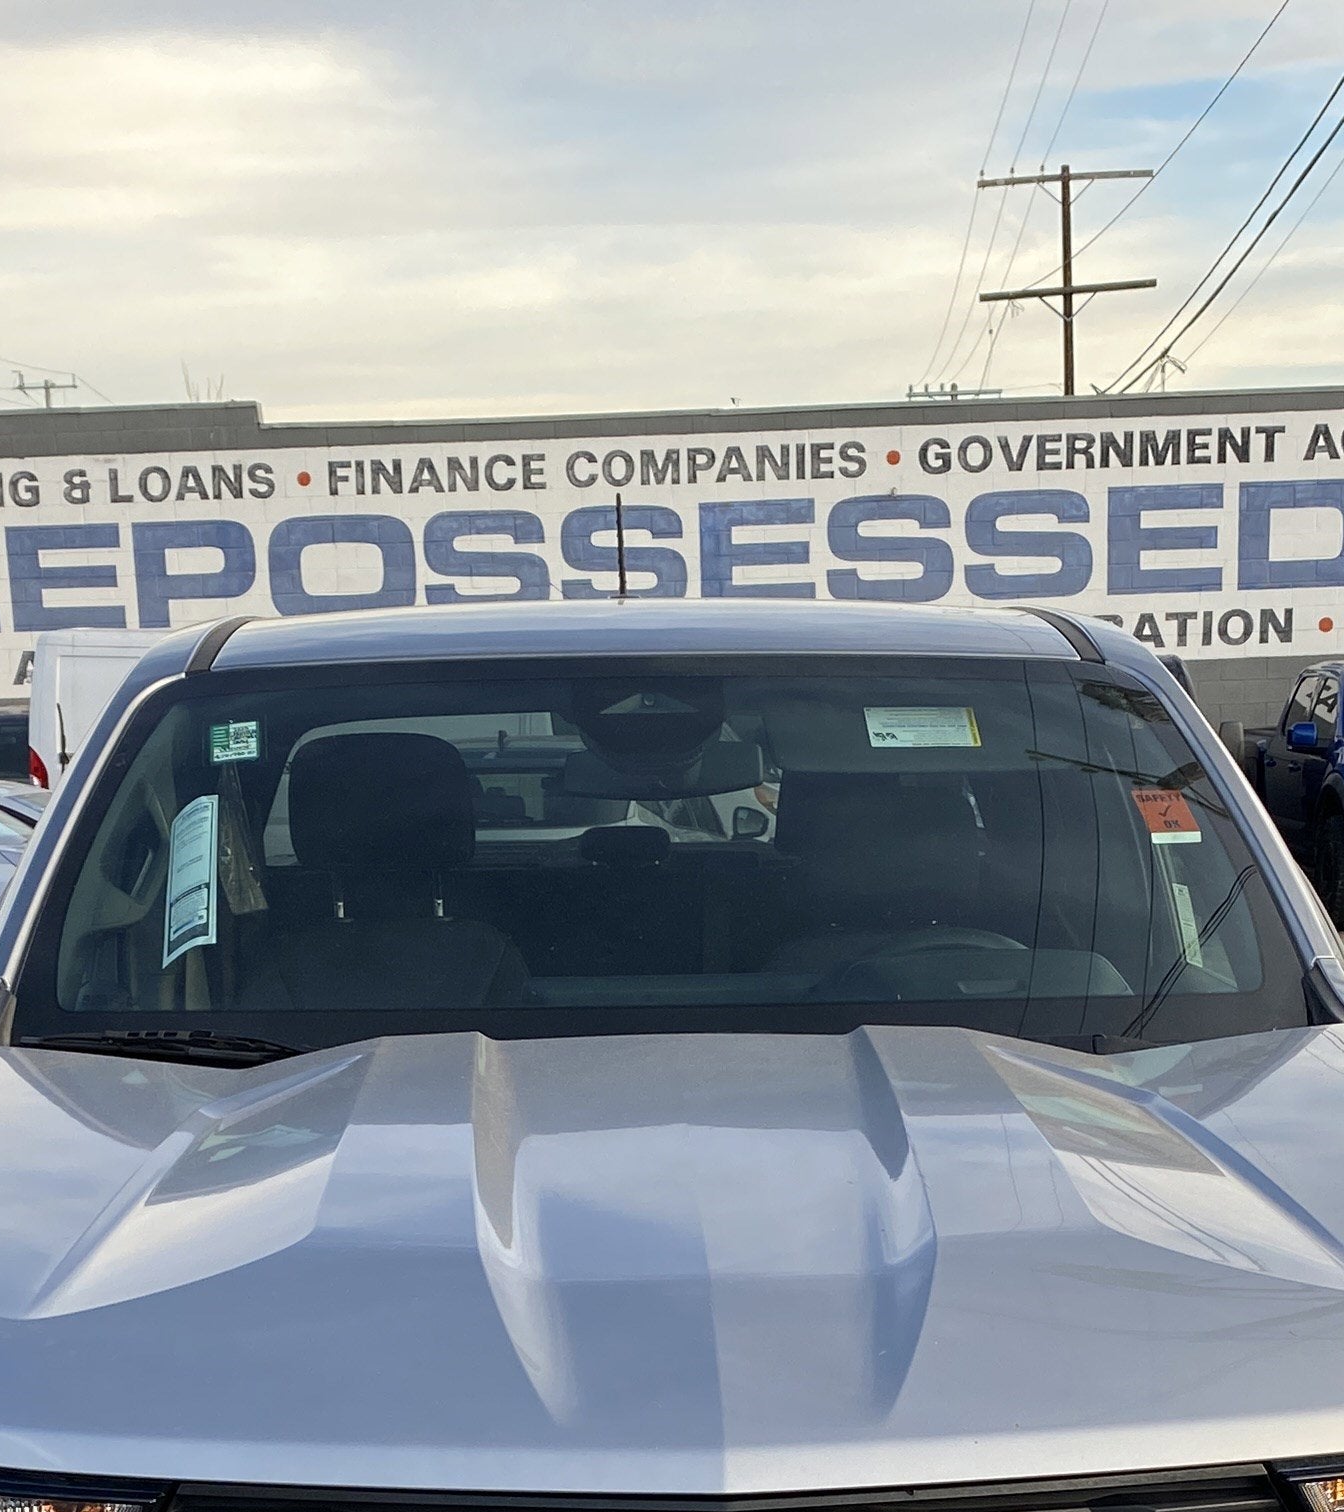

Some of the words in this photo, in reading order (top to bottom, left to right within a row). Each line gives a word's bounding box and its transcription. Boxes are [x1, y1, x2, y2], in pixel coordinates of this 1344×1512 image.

[328, 453, 546, 496] FINANCE
[565, 441, 868, 488] COMPANIES
[918, 425, 1285, 474] GOVERNMENT
[63, 469, 92, 503] &
[109, 462, 276, 503] LOANS
